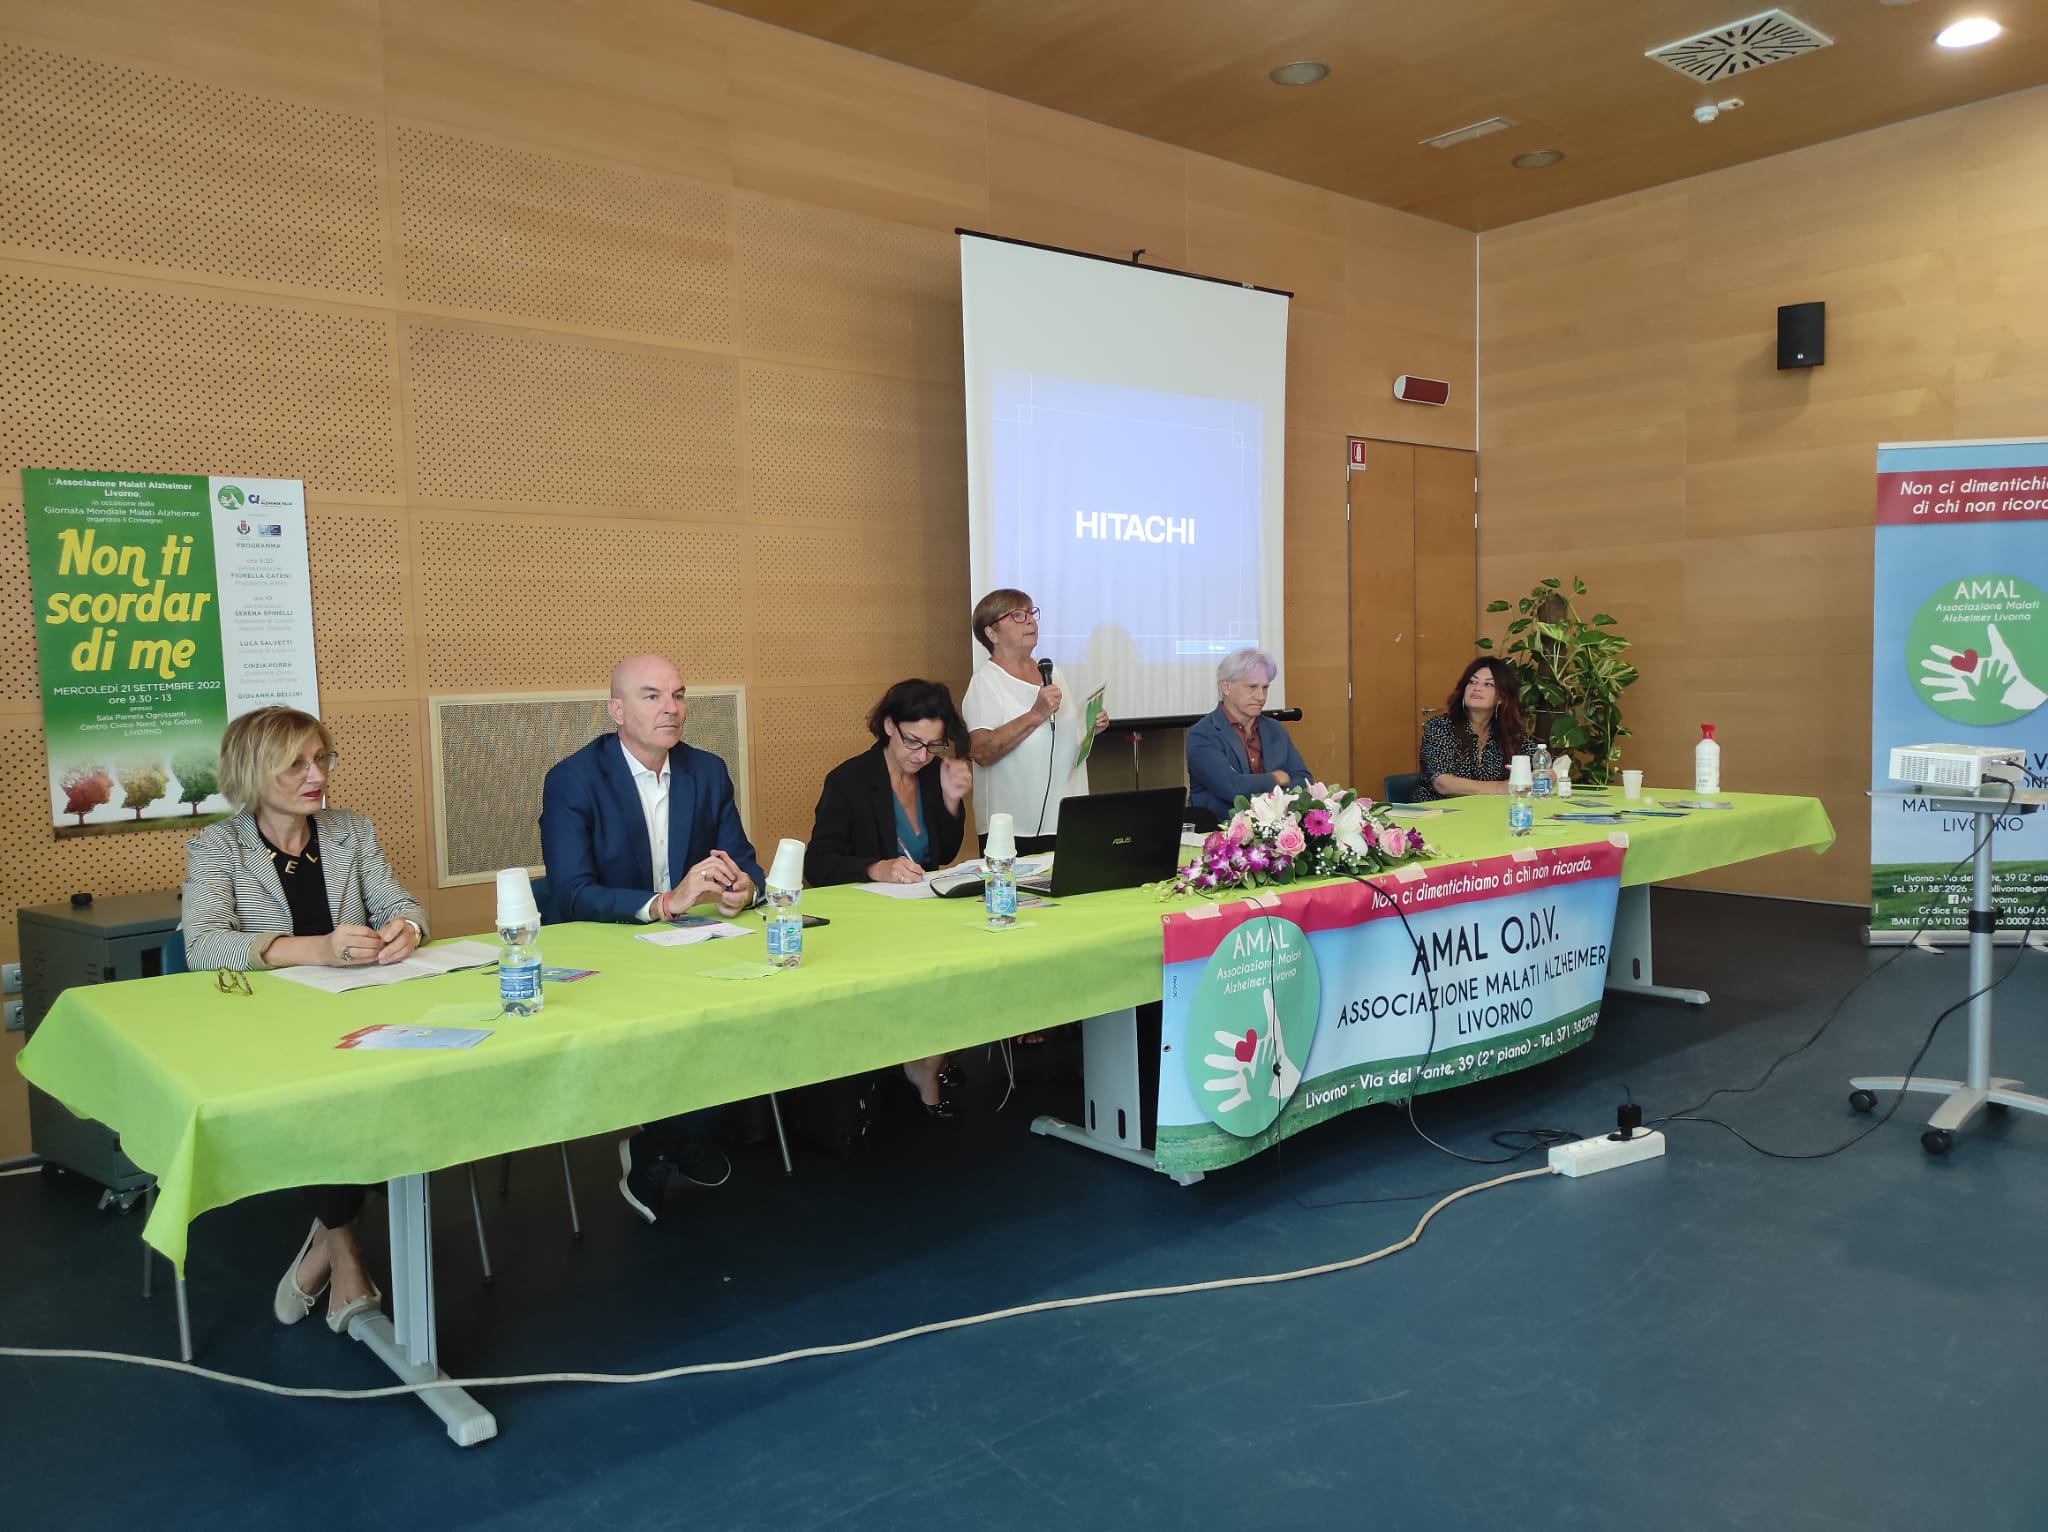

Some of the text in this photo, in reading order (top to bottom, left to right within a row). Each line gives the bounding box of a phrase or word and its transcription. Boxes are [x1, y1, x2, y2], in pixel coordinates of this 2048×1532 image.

[119, 480, 146, 489] Malati
[148, 481, 192, 491] Alzheimer
[1900, 475, 2048, 496] Non ci dimentichi
[44, 506, 200, 518] Giornata Mondiale Malati Alzheimer
[1912, 500, 1929, 515] di
[1934, 499, 1960, 514] chi
[1964, 501, 1996, 513] non
[1075, 510, 1195, 545] HITACHI
[58, 528, 194, 587] Non ti
[1954, 580, 2020, 600] AMAL
[45, 579, 211, 624] scordar
[1935, 600, 2040, 612] Associazione Malati
[1942, 611, 2031, 622] Alzheimer Livorno
[71, 626, 196, 680] di me
[120, 684, 131, 693] 21
[133, 682, 194, 692] SETTEMBRE
[198, 680, 221, 689] 2022
[108, 696, 126, 704] ore
[129, 695, 152, 703] 9.30
[162, 694, 172, 702] 13
[80, 723, 108, 731] Centro
[159, 719, 172, 727] Via
[96, 714, 113, 722] Sala
[124, 729, 162, 737] LIVORNO
[1943, 817, 2023, 832] LIVNO
[1111, 836, 1133, 845] ASUS
[1371, 855, 1592, 910] Non ci dimentichiamo di chi non ricorda.
[1903, 874, 1935, 883] Livorno
[2005, 873, 2017, 882] 39
[1233, 923, 1290, 960] AMAL
[1411, 905, 1559, 976] AMAL O.D.V.
[1216, 950, 1302, 980] Associazione Malati
[1224, 976, 1266, 995] Alzheimer
[1337, 944, 1606, 1029] ASSOCIAZIONE MALATI ALZHEIMER
[1458, 997, 1533, 1035] LIVORNO
[1305, 1084, 1348, 1109] Livorno
[1360, 1073, 1383, 1089] Via
[1388, 1067, 1411, 1085] del
[1459, 1054, 1474, 1072] 39
[1497, 1038, 1532, 1064] piano)
[1540, 1034, 1555, 1049] Tel.
[1557, 1025, 1570, 1042] 371
[1573, 1012, 1599, 1035] 382292
